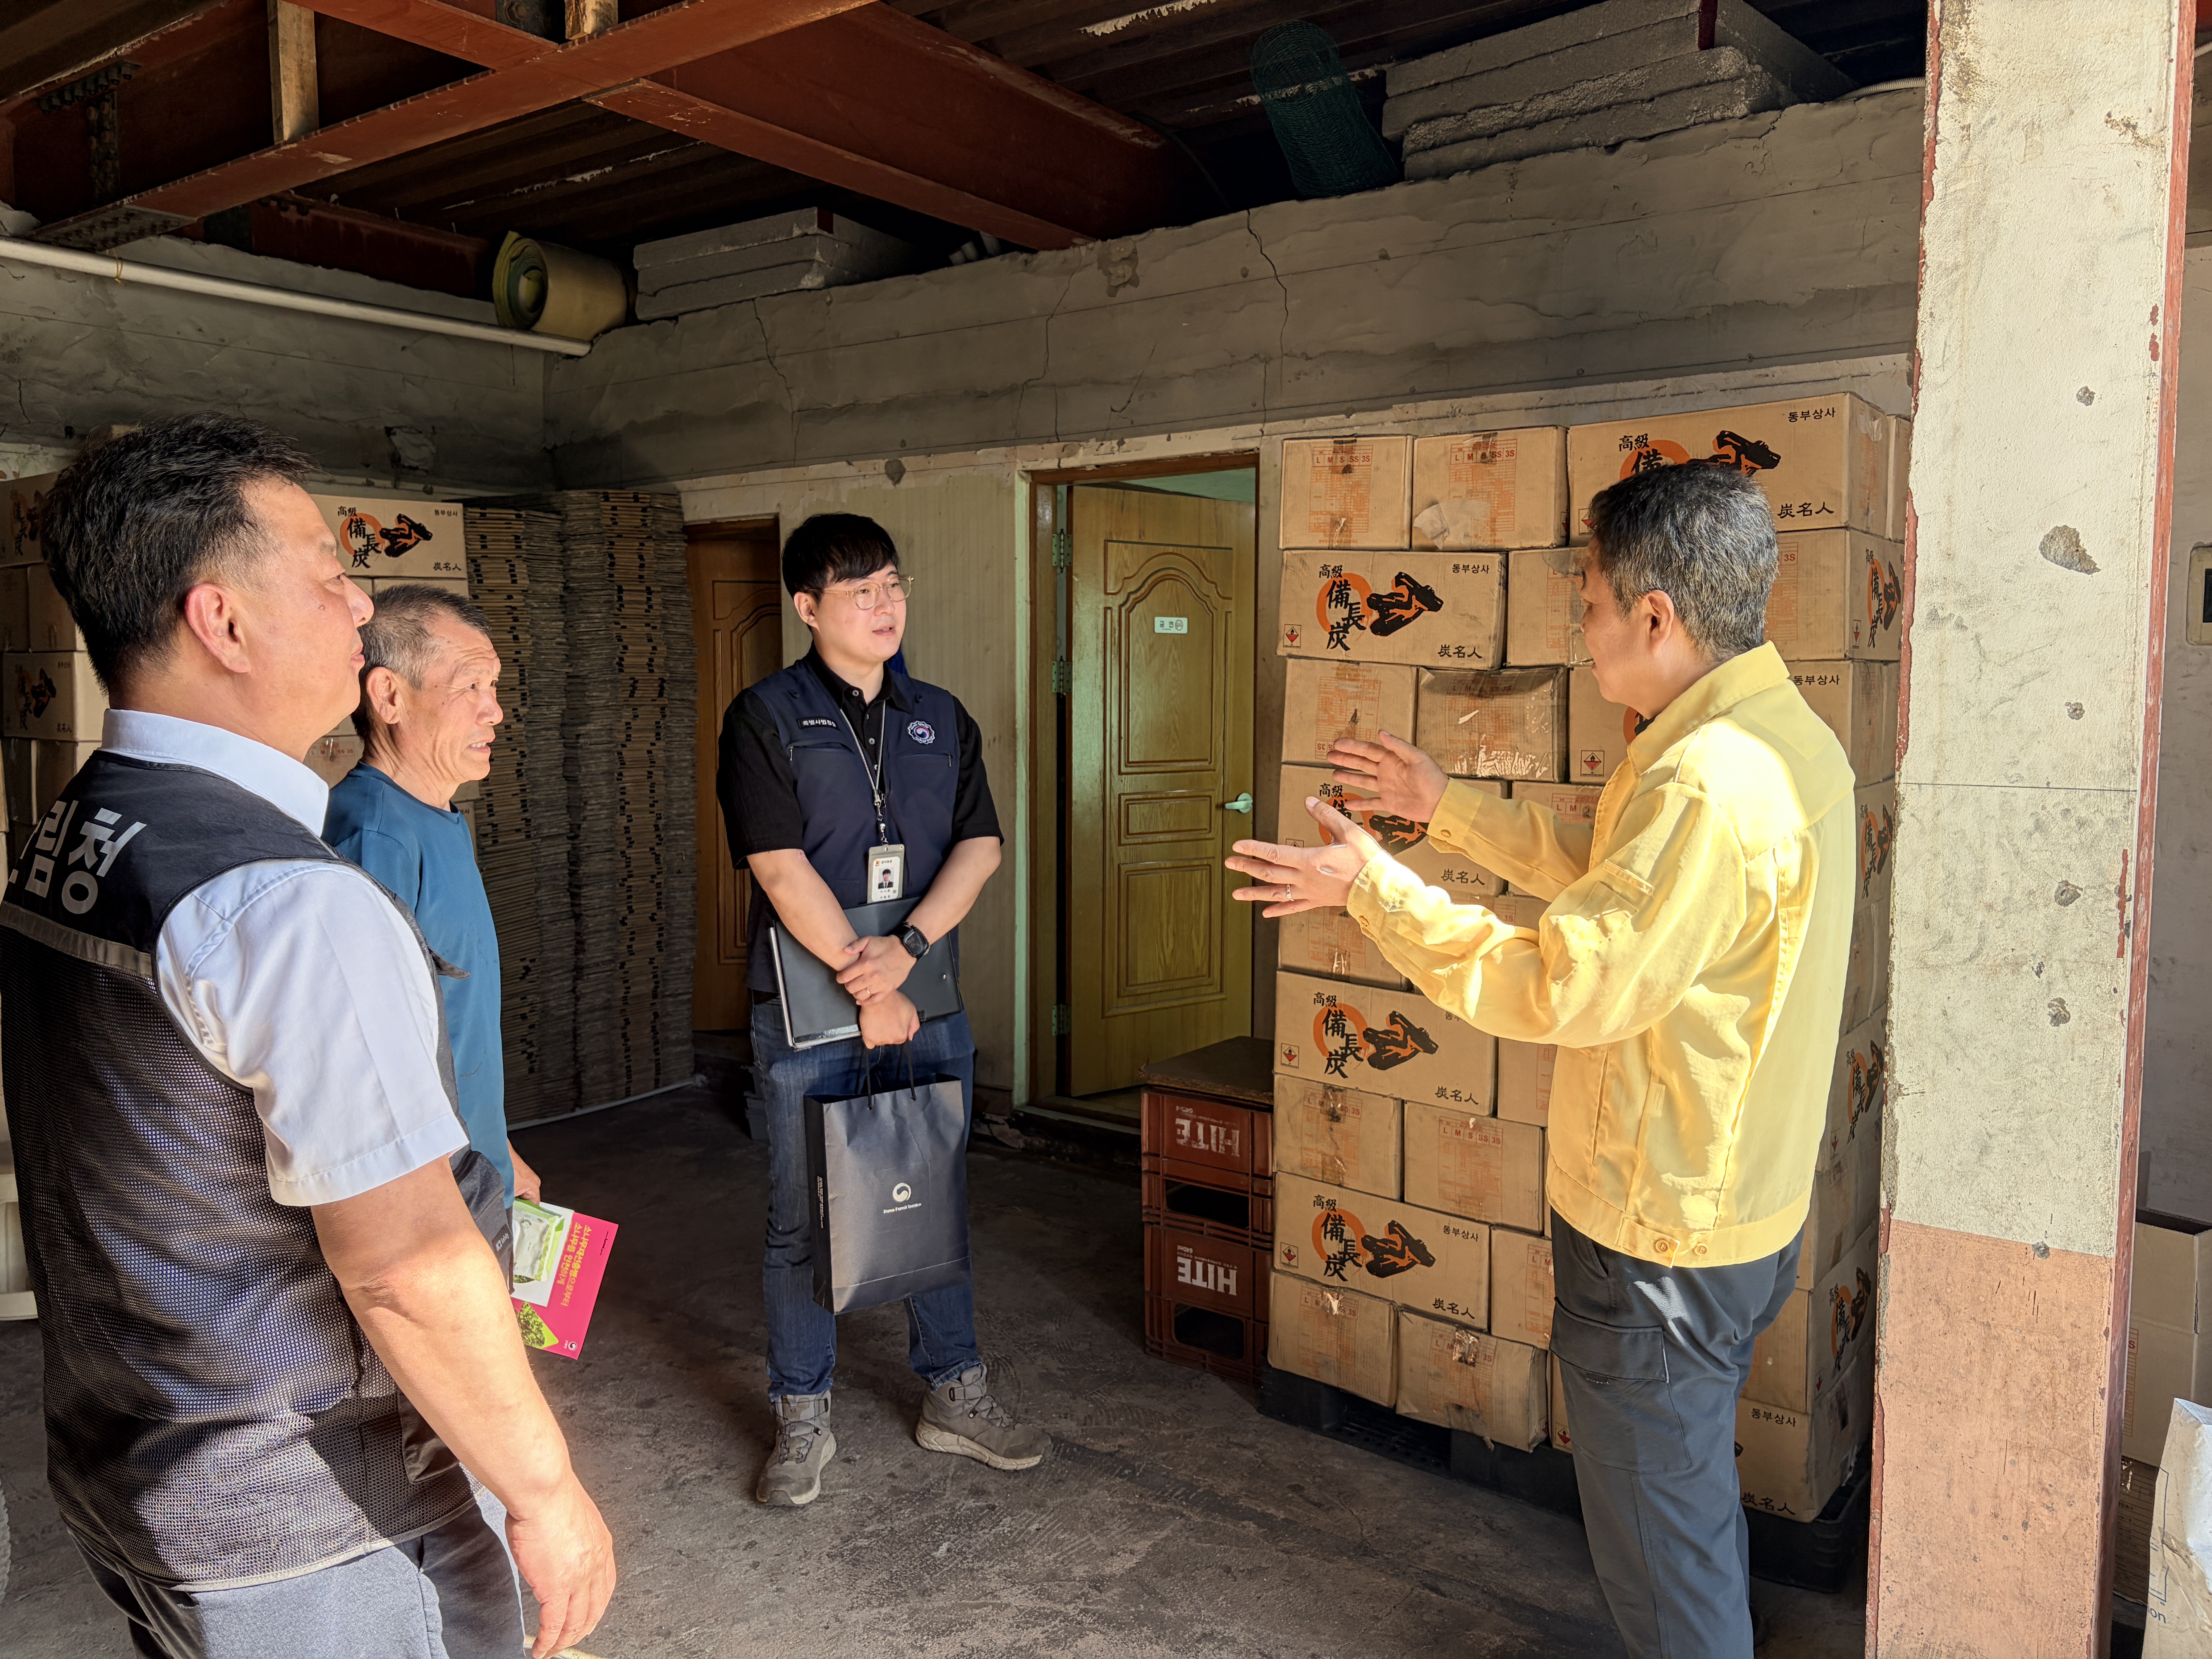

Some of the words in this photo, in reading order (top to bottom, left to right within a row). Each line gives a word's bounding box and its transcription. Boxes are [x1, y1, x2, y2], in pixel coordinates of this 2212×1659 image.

[1788, 407, 1836, 423] 동부상사
[1619, 433, 1650, 452] 高級
[338, 506, 357, 517] 高級
[1778, 501, 1834, 519] 炭名人
[347, 518, 382, 568] 備長炭
[1319, 564, 1343, 579] 高級
[1452, 564, 1489, 574] 동부상사
[1326, 579, 1366, 651] 備長炭
[1437, 644, 1482, 658] 炭名人
[1793, 675, 1840, 685] 동부상사
[1319, 783, 1343, 798] 高級
[9, 800, 147, 914] 림청
[1441, 868, 1485, 886] 炭名人
[1313, 992, 1337, 1008] 高級
[1322, 1009, 1364, 1079] 備長炭
[1435, 1085, 1479, 1105] 炭名人
[1175, 1118, 1240, 1157] HITE
[1313, 1194, 1337, 1212] 高級
[1443, 1224, 1479, 1242] 동부상사
[1321, 1213, 1363, 1282] 備長炭
[1177, 1256, 1237, 1296] HITE
[1433, 1297, 1475, 1319] 炭名人
[2128, 1340, 2135, 1349] S
[1751, 1408, 1796, 1427] 동부상사
[1741, 1492, 1795, 1515] 炭名人
